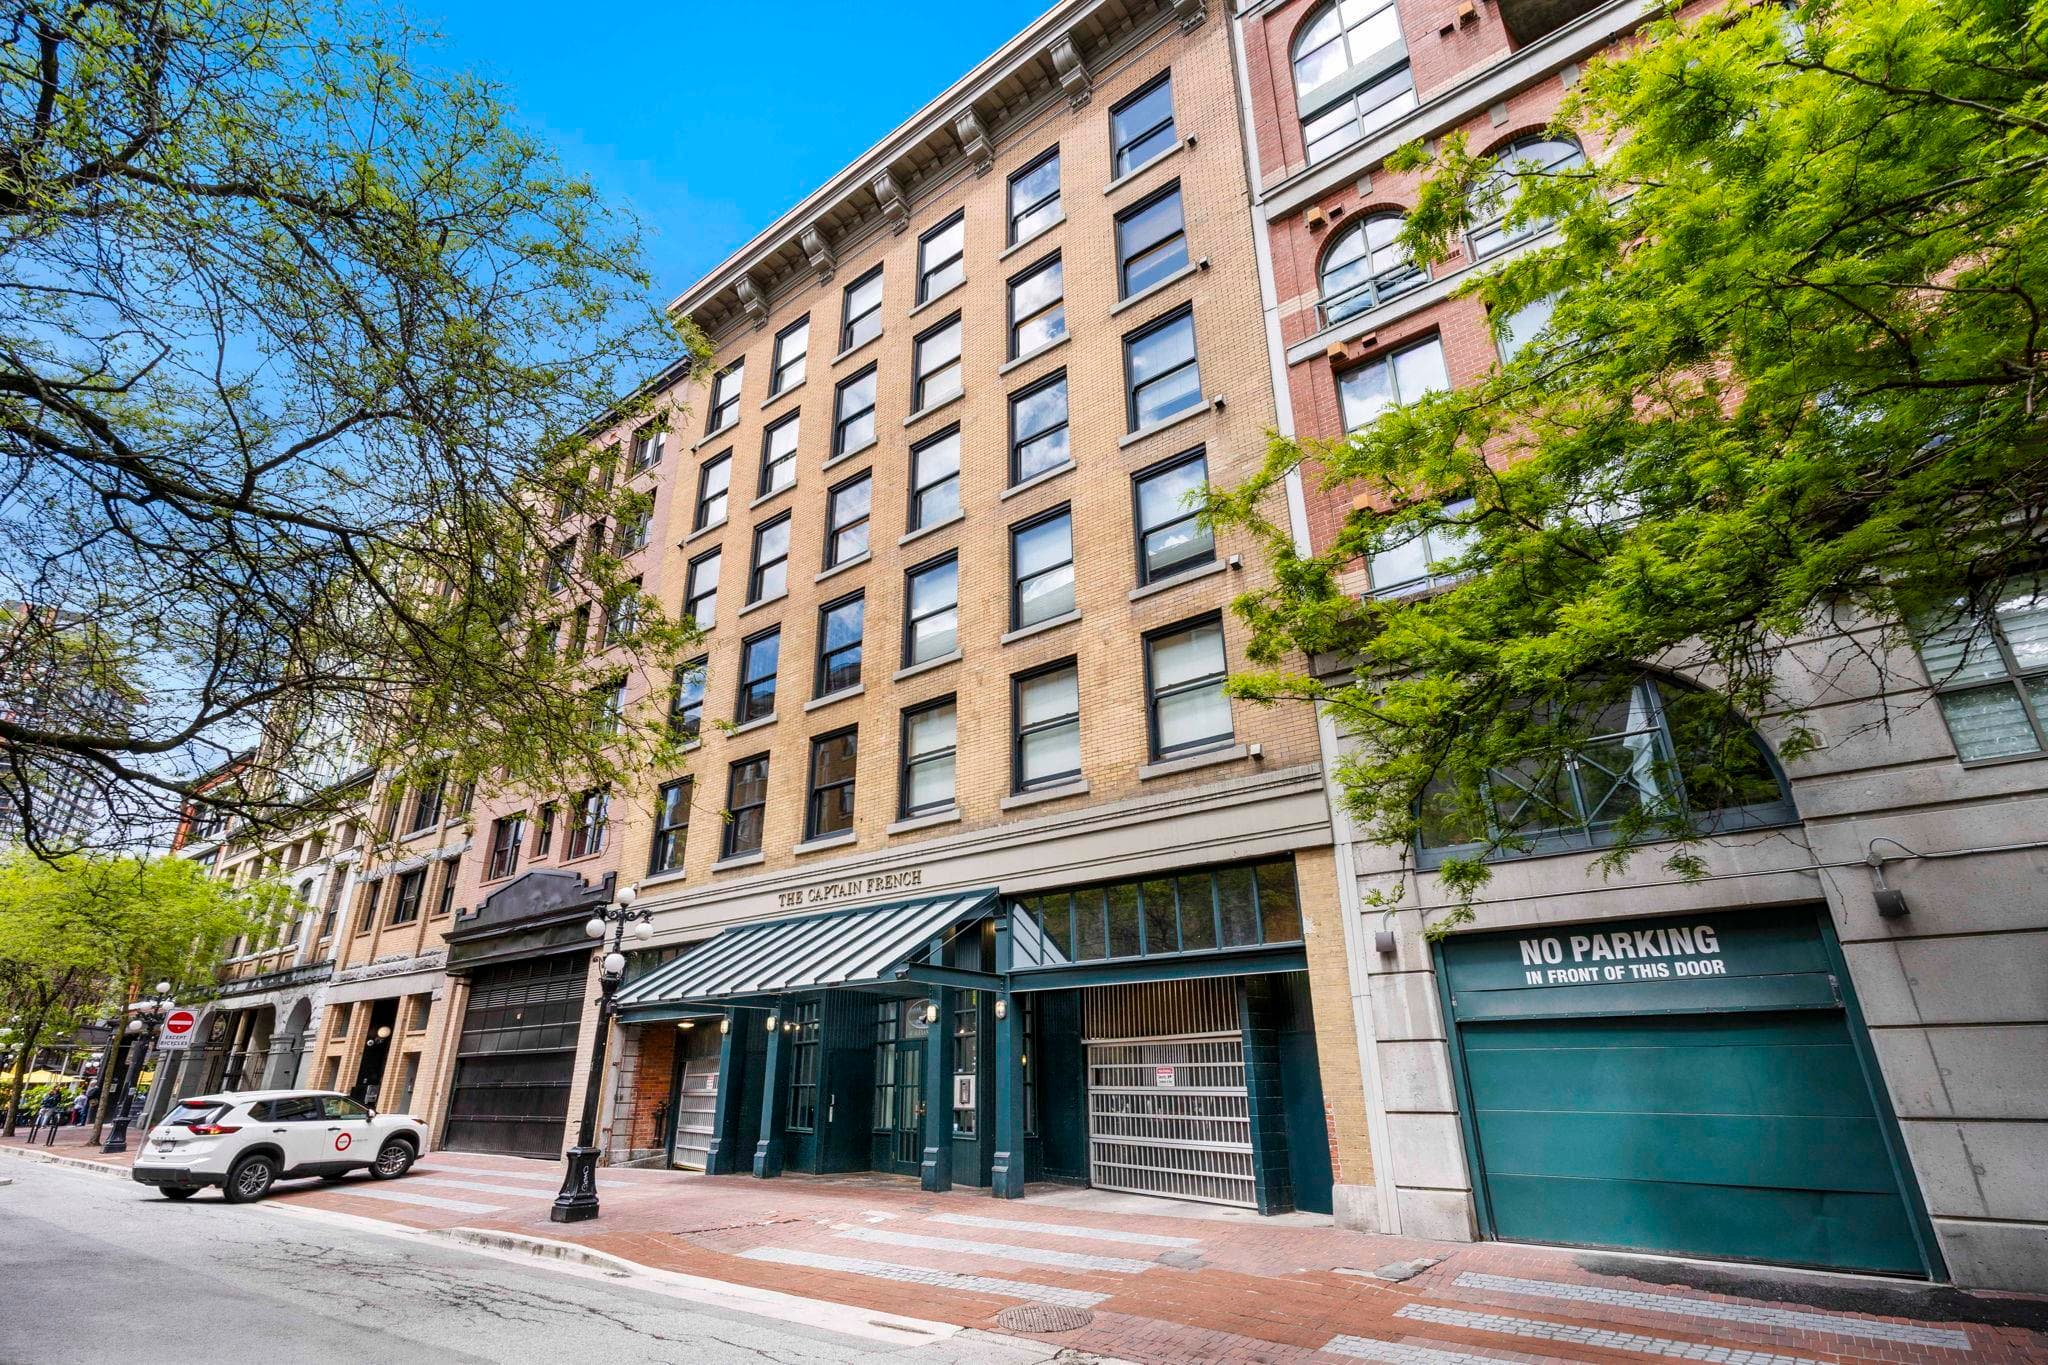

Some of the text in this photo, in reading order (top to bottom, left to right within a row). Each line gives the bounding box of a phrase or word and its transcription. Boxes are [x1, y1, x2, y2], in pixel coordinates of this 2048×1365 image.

[778, 870, 922, 907] THE CAPTAIN FRENCH
[1519, 925, 1720, 966] NO PARKING
[1525, 959, 1726, 985] IN FRONT OF THIS DOOR
